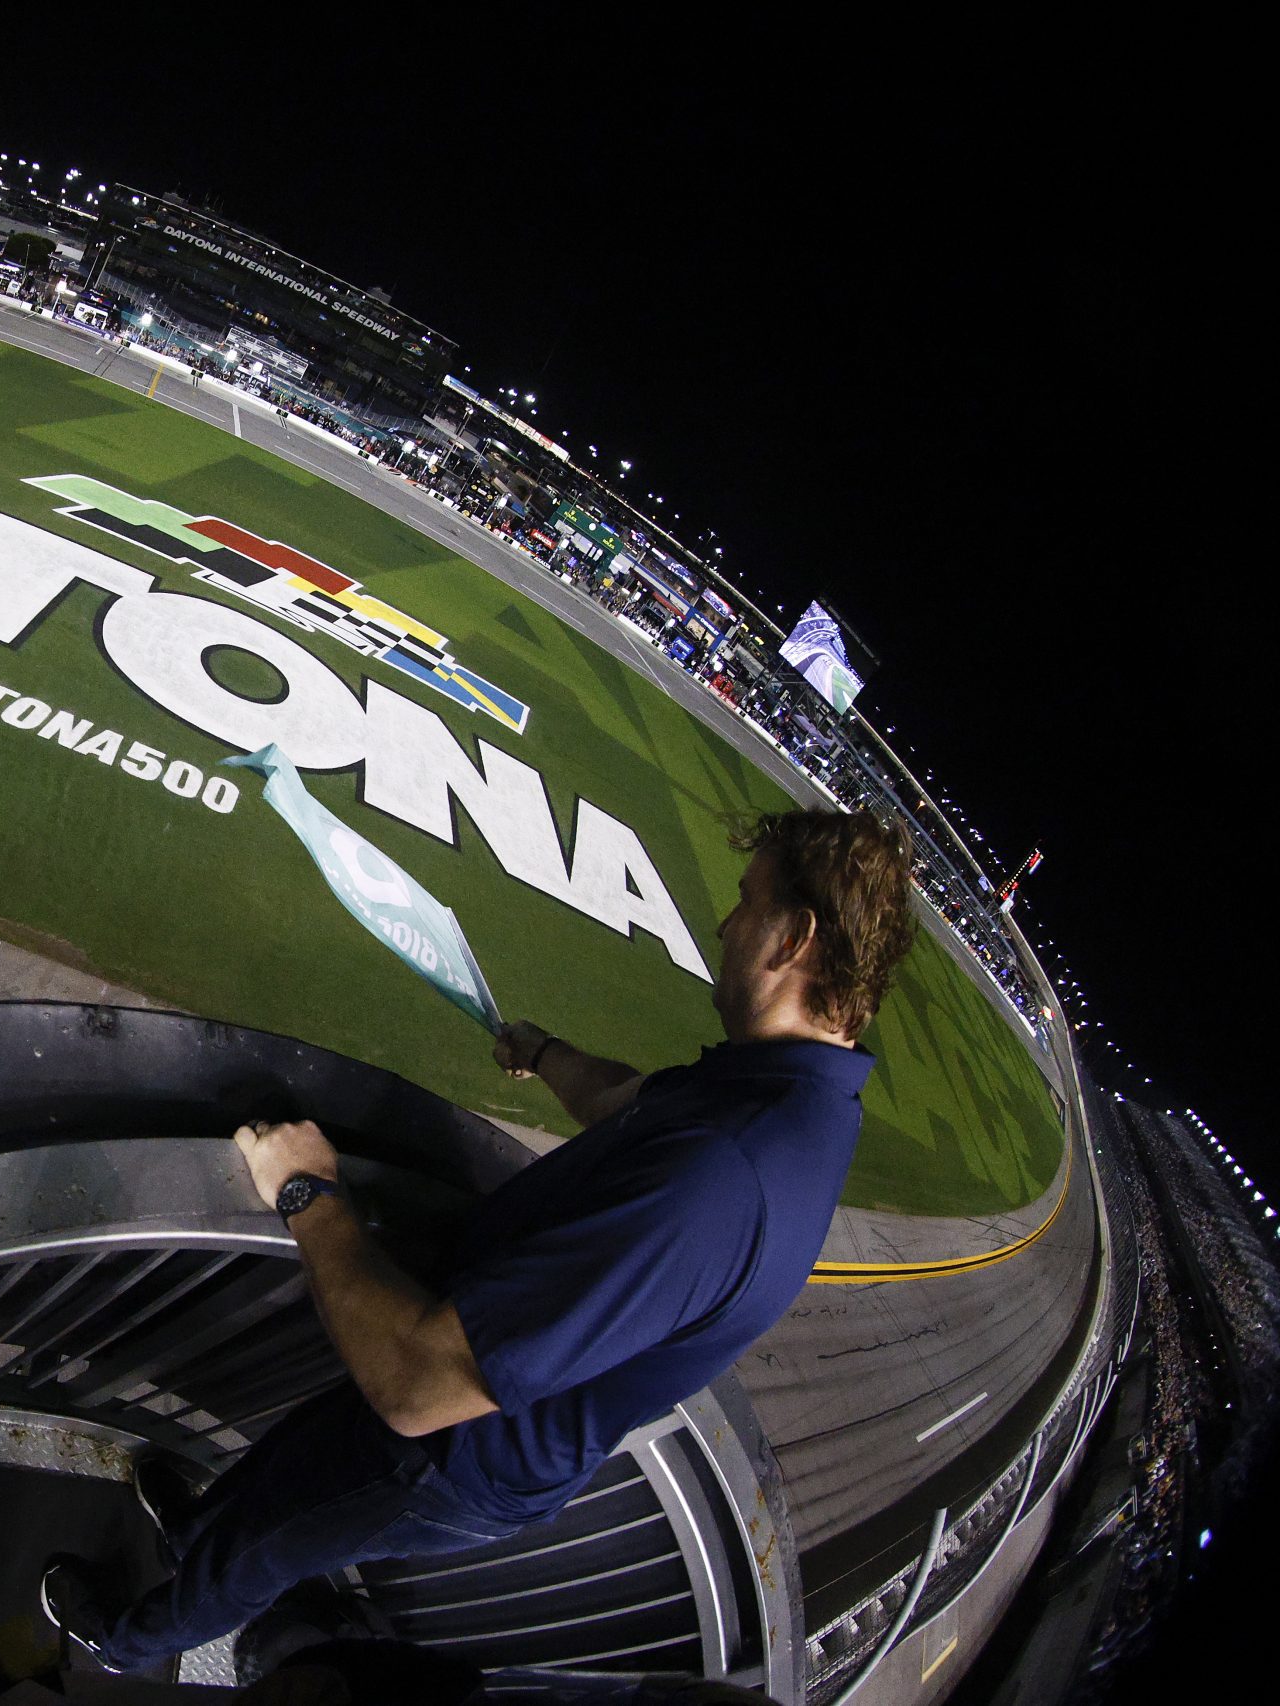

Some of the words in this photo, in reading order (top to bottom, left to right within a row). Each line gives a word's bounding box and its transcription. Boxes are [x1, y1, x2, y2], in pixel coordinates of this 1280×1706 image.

[163, 225, 223, 256] DAYTONA
[224, 249, 328, 305] INTERNATIONAL
[331, 301, 400, 341] SPEEDWAY
